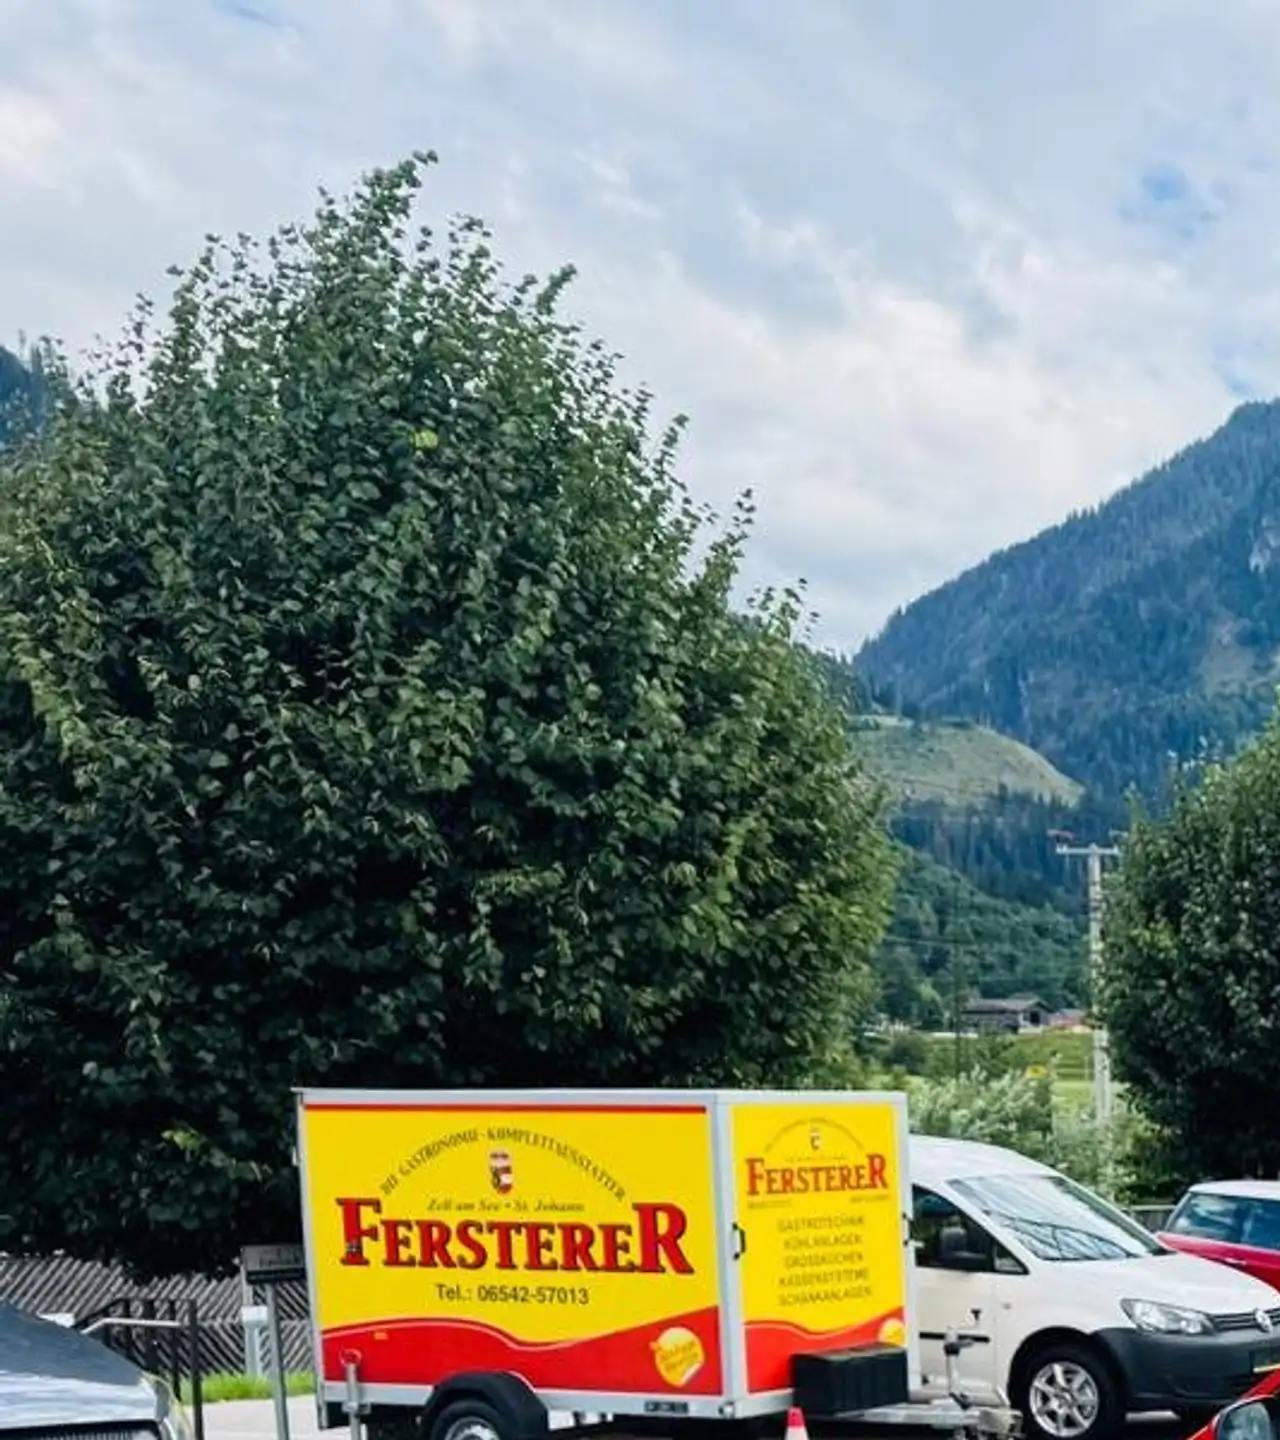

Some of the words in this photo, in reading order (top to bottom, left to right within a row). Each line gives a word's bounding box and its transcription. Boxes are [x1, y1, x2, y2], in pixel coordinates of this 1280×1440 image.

[744, 1153, 889, 1196] FERSTERER
[533, 1199, 585, 1212] Johann
[336, 1196, 695, 1275] FERSTERER
[435, 1283, 473, 1301] Tel.:
[477, 1284, 590, 1305] 06542-57013
